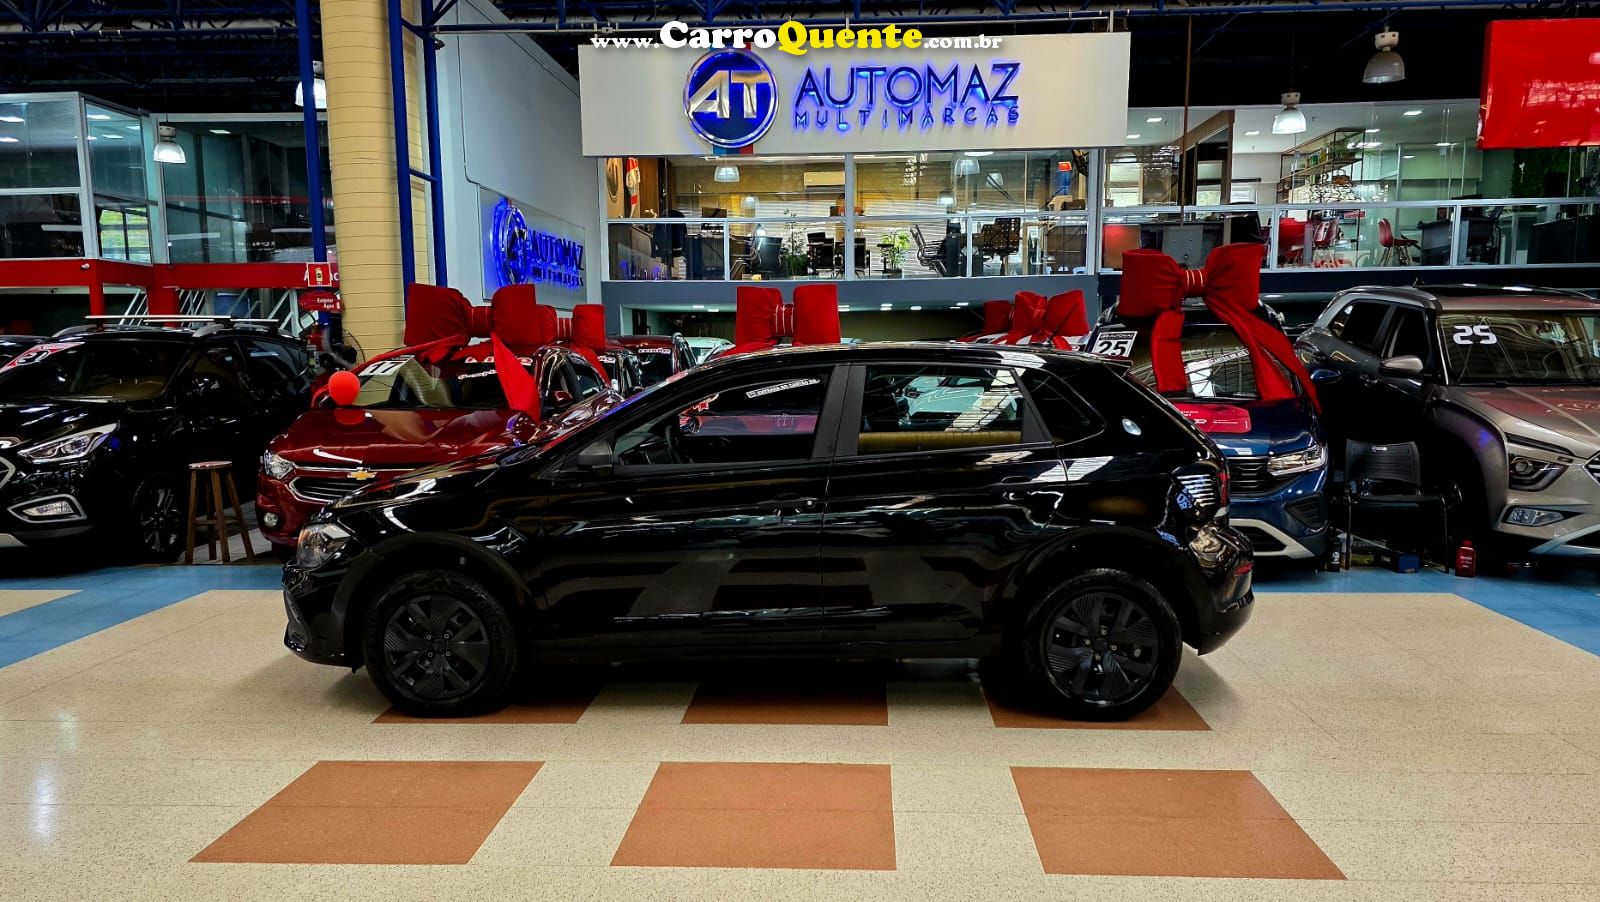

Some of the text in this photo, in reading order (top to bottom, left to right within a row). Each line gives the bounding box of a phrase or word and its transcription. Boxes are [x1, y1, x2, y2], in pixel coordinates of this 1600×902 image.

[687, 69, 771, 119] AT
[794, 62, 1021, 107] AUTOMAZ
[795, 106, 1020, 129] MULTIMARCAS
[529, 229, 584, 271] AUTOMAZ
[1452, 324, 1498, 345] 25
[1098, 340, 1129, 357] 25
[367, 361, 405, 374] 17
